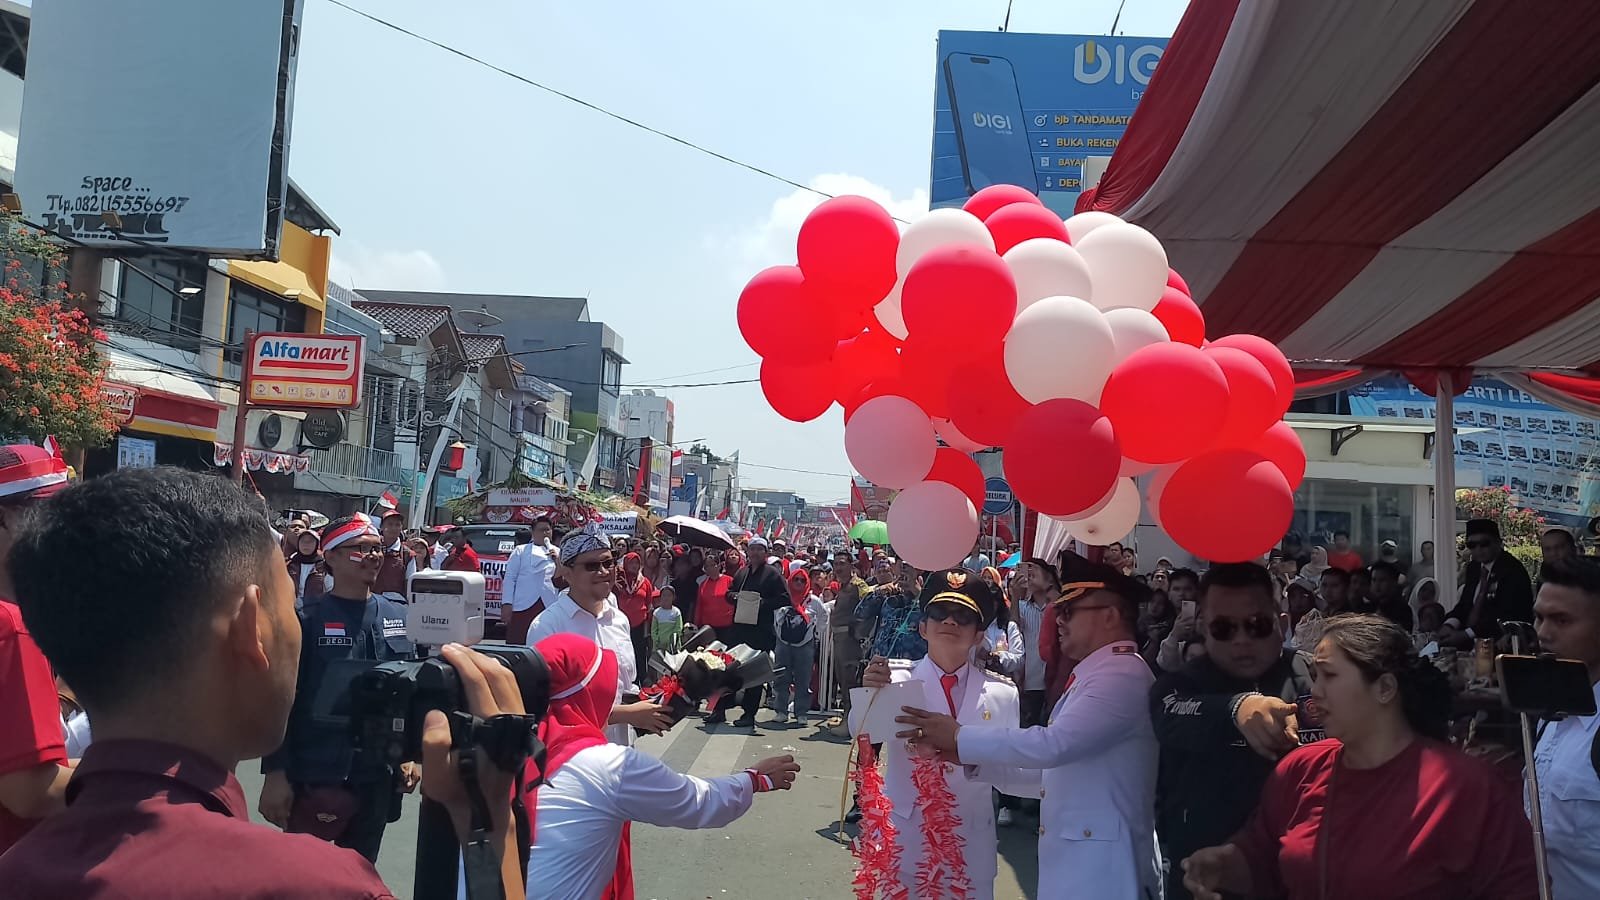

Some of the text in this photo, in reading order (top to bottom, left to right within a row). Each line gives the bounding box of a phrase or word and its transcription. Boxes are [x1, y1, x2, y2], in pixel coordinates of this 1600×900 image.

[1056, 138, 1084, 147] BUKA
[260, 341, 350, 361] Alfamart
[421, 616, 449, 625] Ulanzi
